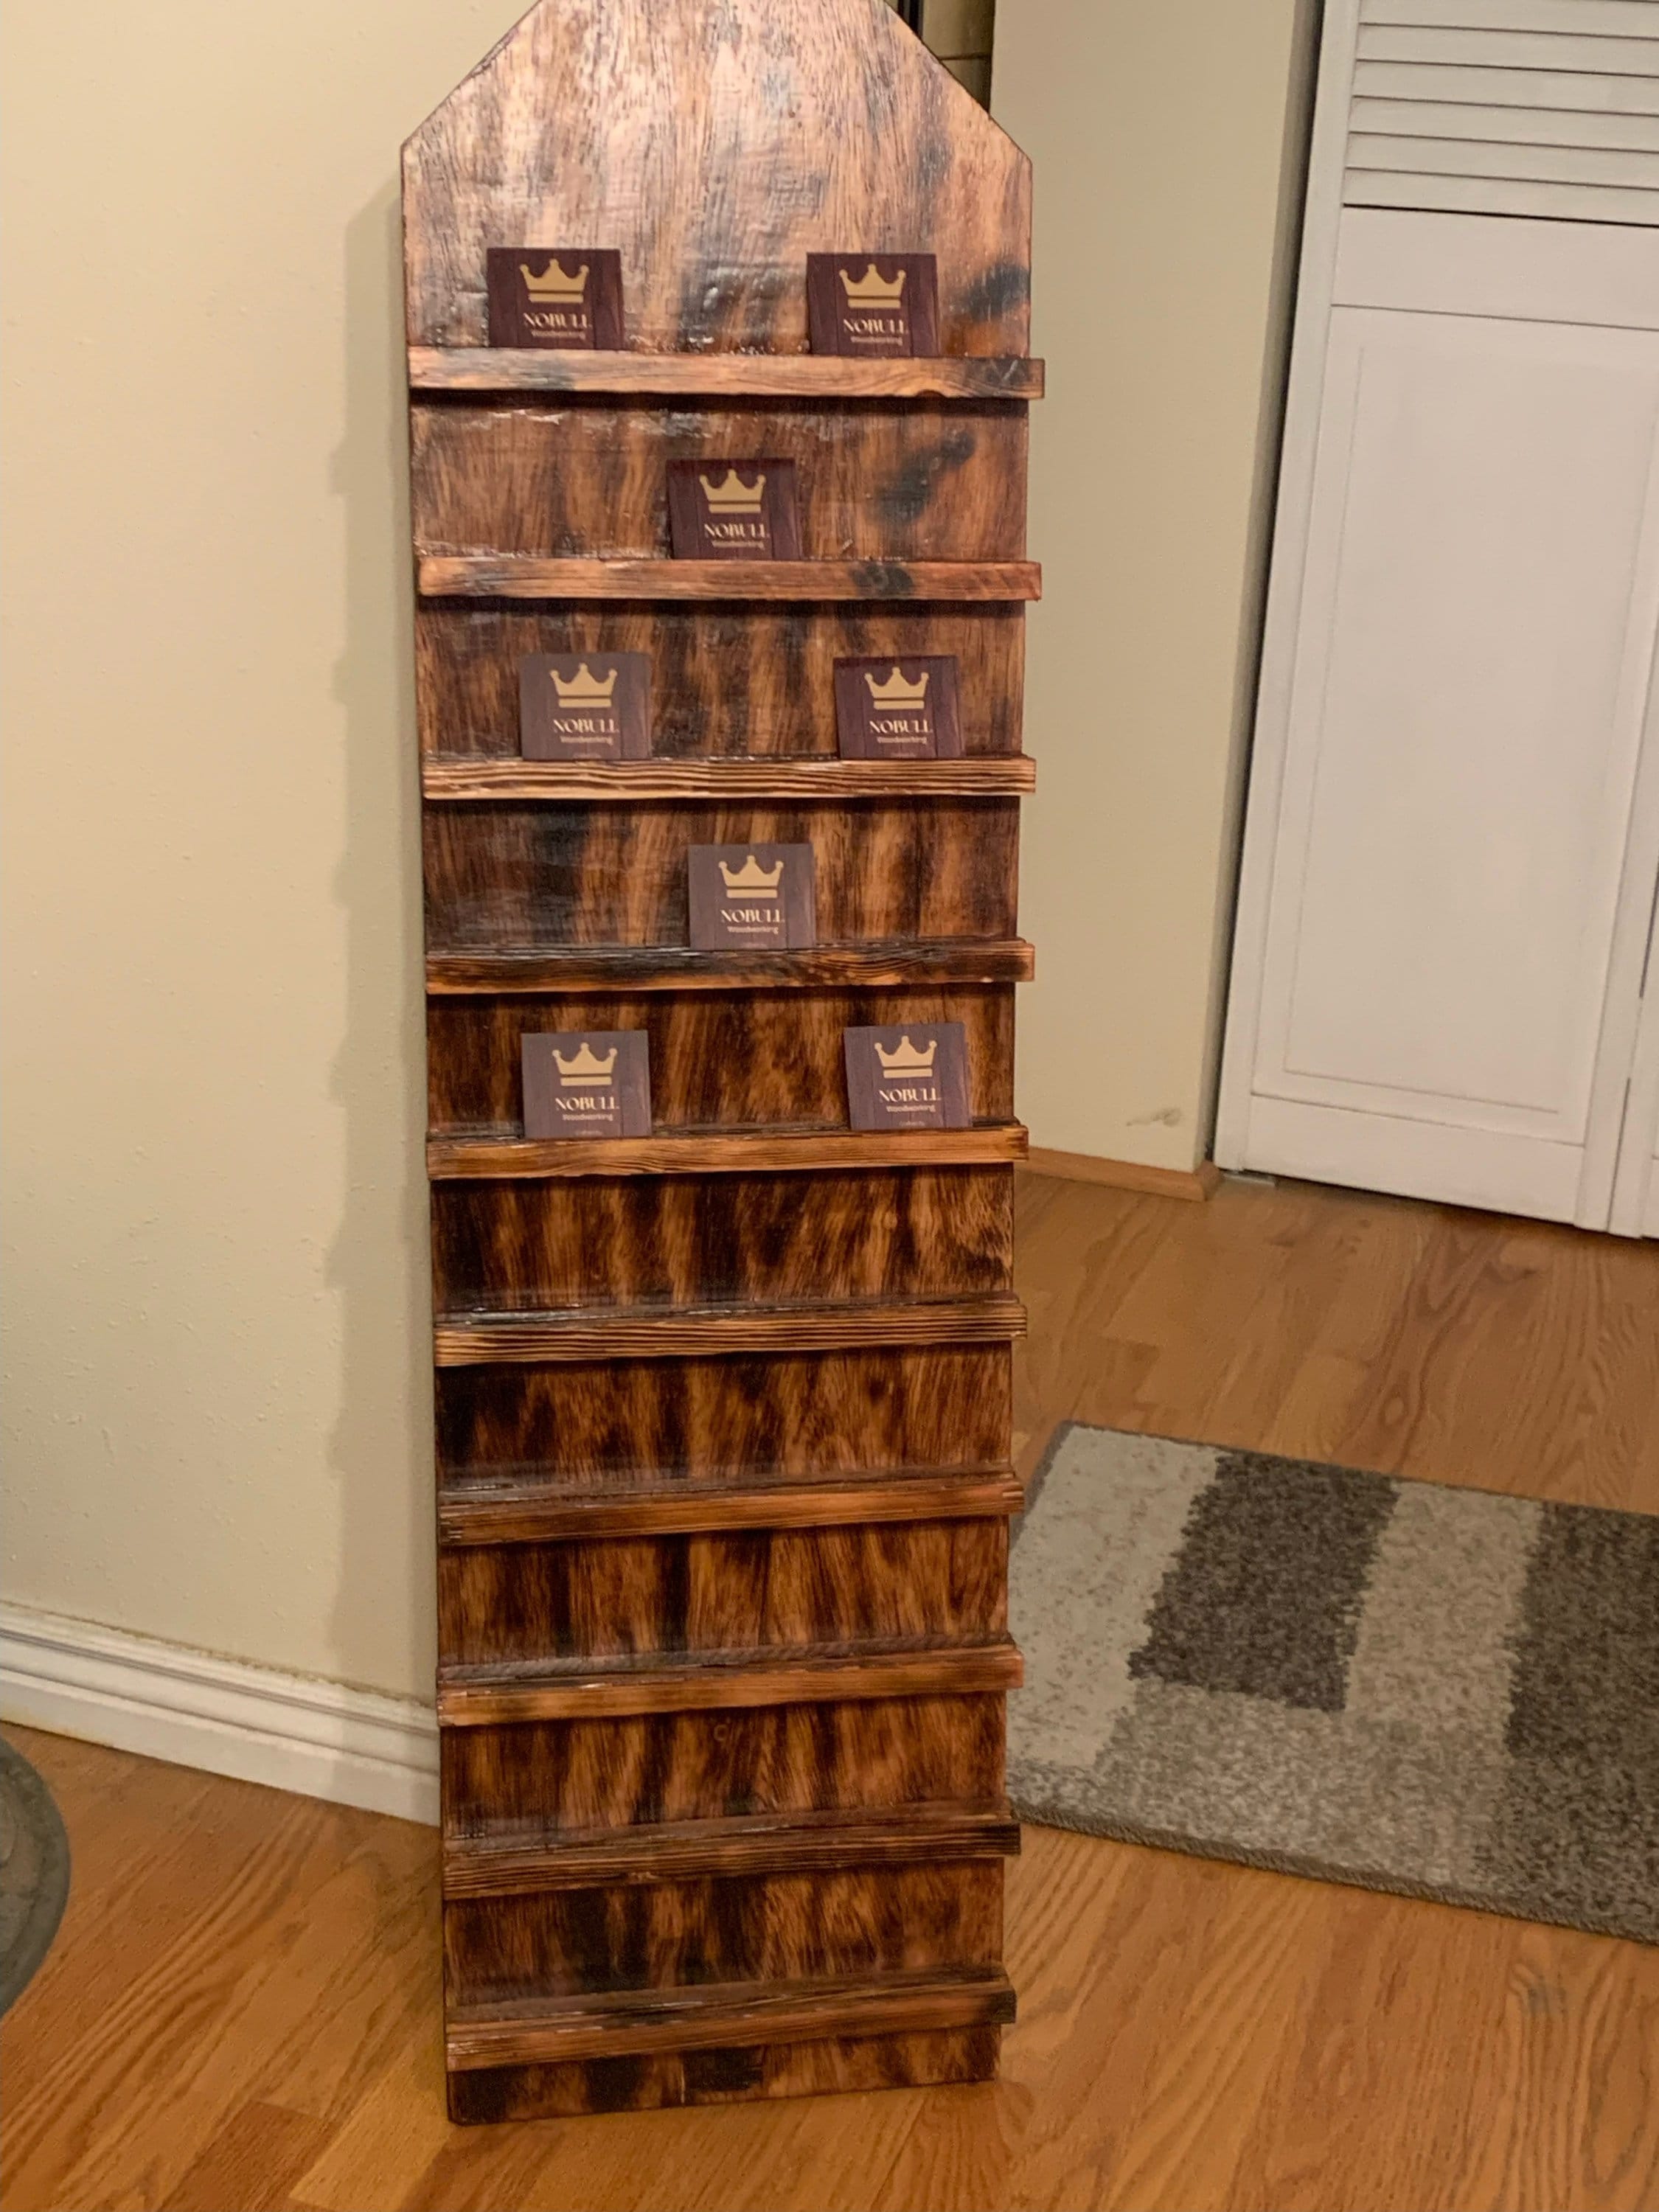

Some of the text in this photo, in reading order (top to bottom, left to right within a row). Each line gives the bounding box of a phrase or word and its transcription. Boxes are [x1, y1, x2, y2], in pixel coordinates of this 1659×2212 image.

[524, 312, 593, 328] NOBULL
[844, 318, 908, 335] NOBULL
[704, 523, 770, 538] NOBULL
[553, 718, 619, 733] NOBULL
[869, 720, 933, 734] NOBULL
[720, 908, 785, 922] NOBULL
[554, 1096, 619, 1110] NOBULL
[878, 1088, 942, 1103] NOBULL
